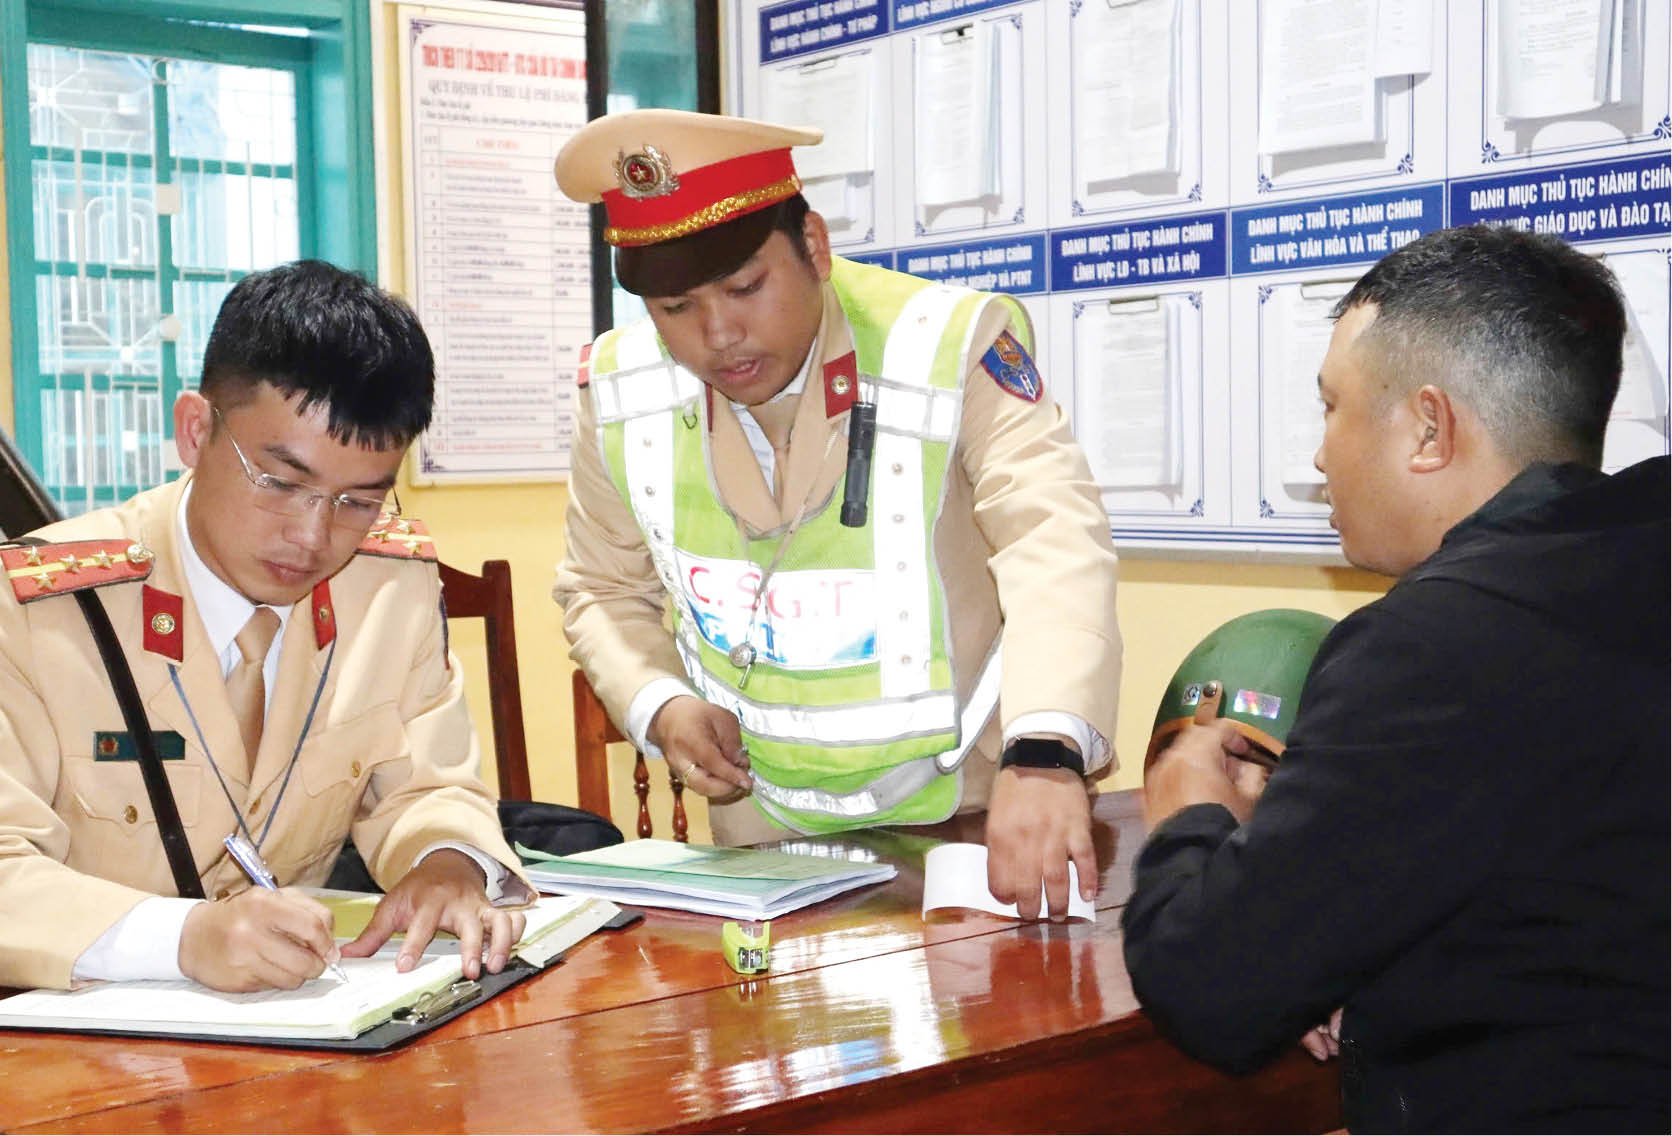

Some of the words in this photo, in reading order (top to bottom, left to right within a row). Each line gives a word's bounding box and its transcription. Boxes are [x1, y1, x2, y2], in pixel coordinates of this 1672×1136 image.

[1470, 188, 1505, 211] DANH
[1508, 184, 1537, 208] MỤC
[1541, 174, 1566, 202] THỦ
[1569, 176, 1595, 202] TỤC
[1599, 170, 1637, 196] HÀNH
[1248, 217, 1277, 236] DANH
[1278, 214, 1304, 235] MỤC
[1305, 205, 1327, 230] THỦ
[1328, 208, 1350, 230] TỤC
[1352, 202, 1384, 225] HÀNH
[1386, 198, 1423, 220] CHÍNH
[1534, 211, 1565, 235] GIÁO
[1568, 209, 1596, 235] DỤC
[1600, 203, 1617, 228] VÀ
[1621, 201, 1650, 227] ĐÀO
[1061, 238, 1087, 256] DANH
[1088, 235, 1111, 255] MỤC
[1112, 227, 1131, 250] THỦ
[1132, 230, 1151, 251] TỤC
[1151, 225, 1180, 246] HÀNH
[1181, 221, 1214, 243] CHÍNH
[1250, 243, 1275, 264] LĨNH
[1277, 241, 1299, 264] VỰC
[1300, 237, 1322, 258] VĂN
[1324, 235, 1348, 256] HÓA
[1349, 232, 1365, 253] VÀ
[1366, 226, 1388, 252] THỂ
[1073, 261, 1095, 282] LĨNH
[1096, 260, 1116, 283] VỰC
[1136, 257, 1150, 276] TB
[1151, 253, 1165, 274] VÀ
[1166, 252, 1180, 273] XÃ
[1181, 249, 1200, 274] HỘI
